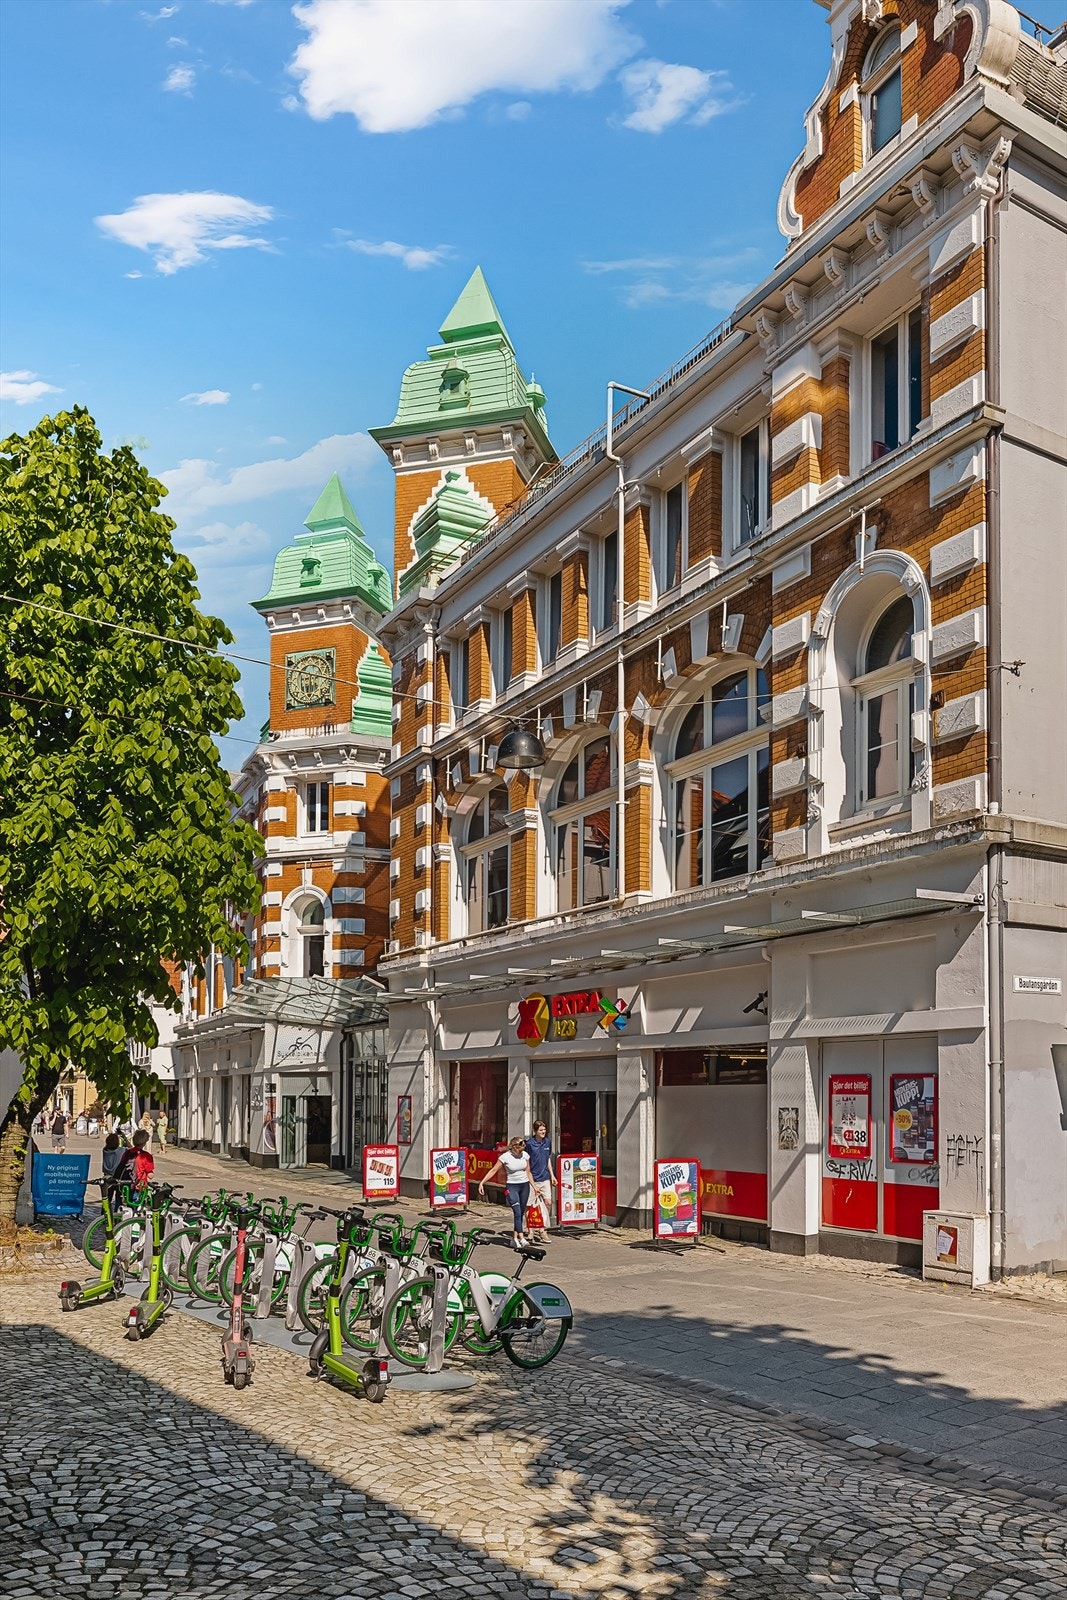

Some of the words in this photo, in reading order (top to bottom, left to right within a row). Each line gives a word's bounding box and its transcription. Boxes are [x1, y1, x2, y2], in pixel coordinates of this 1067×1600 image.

[552, 992, 601, 1016] EXTRA
[844, 1082, 853, 1090] det
[894, 1080, 917, 1097] MEDLEMS-
[895, 1085, 920, 1108] KUPP!
[854, 1130, 867, 1143] 38
[435, 1156, 455, 1171] KUPP!
[477, 1160, 493, 1169] EXTRA
[659, 1165, 681, 1179] MEDLEMS-
[383, 1177, 395, 1186] 119
[660, 1169, 685, 1189] KUPP!
[706, 1183, 733, 1196] EXTRA
[663, 1195, 672, 1203] 75
